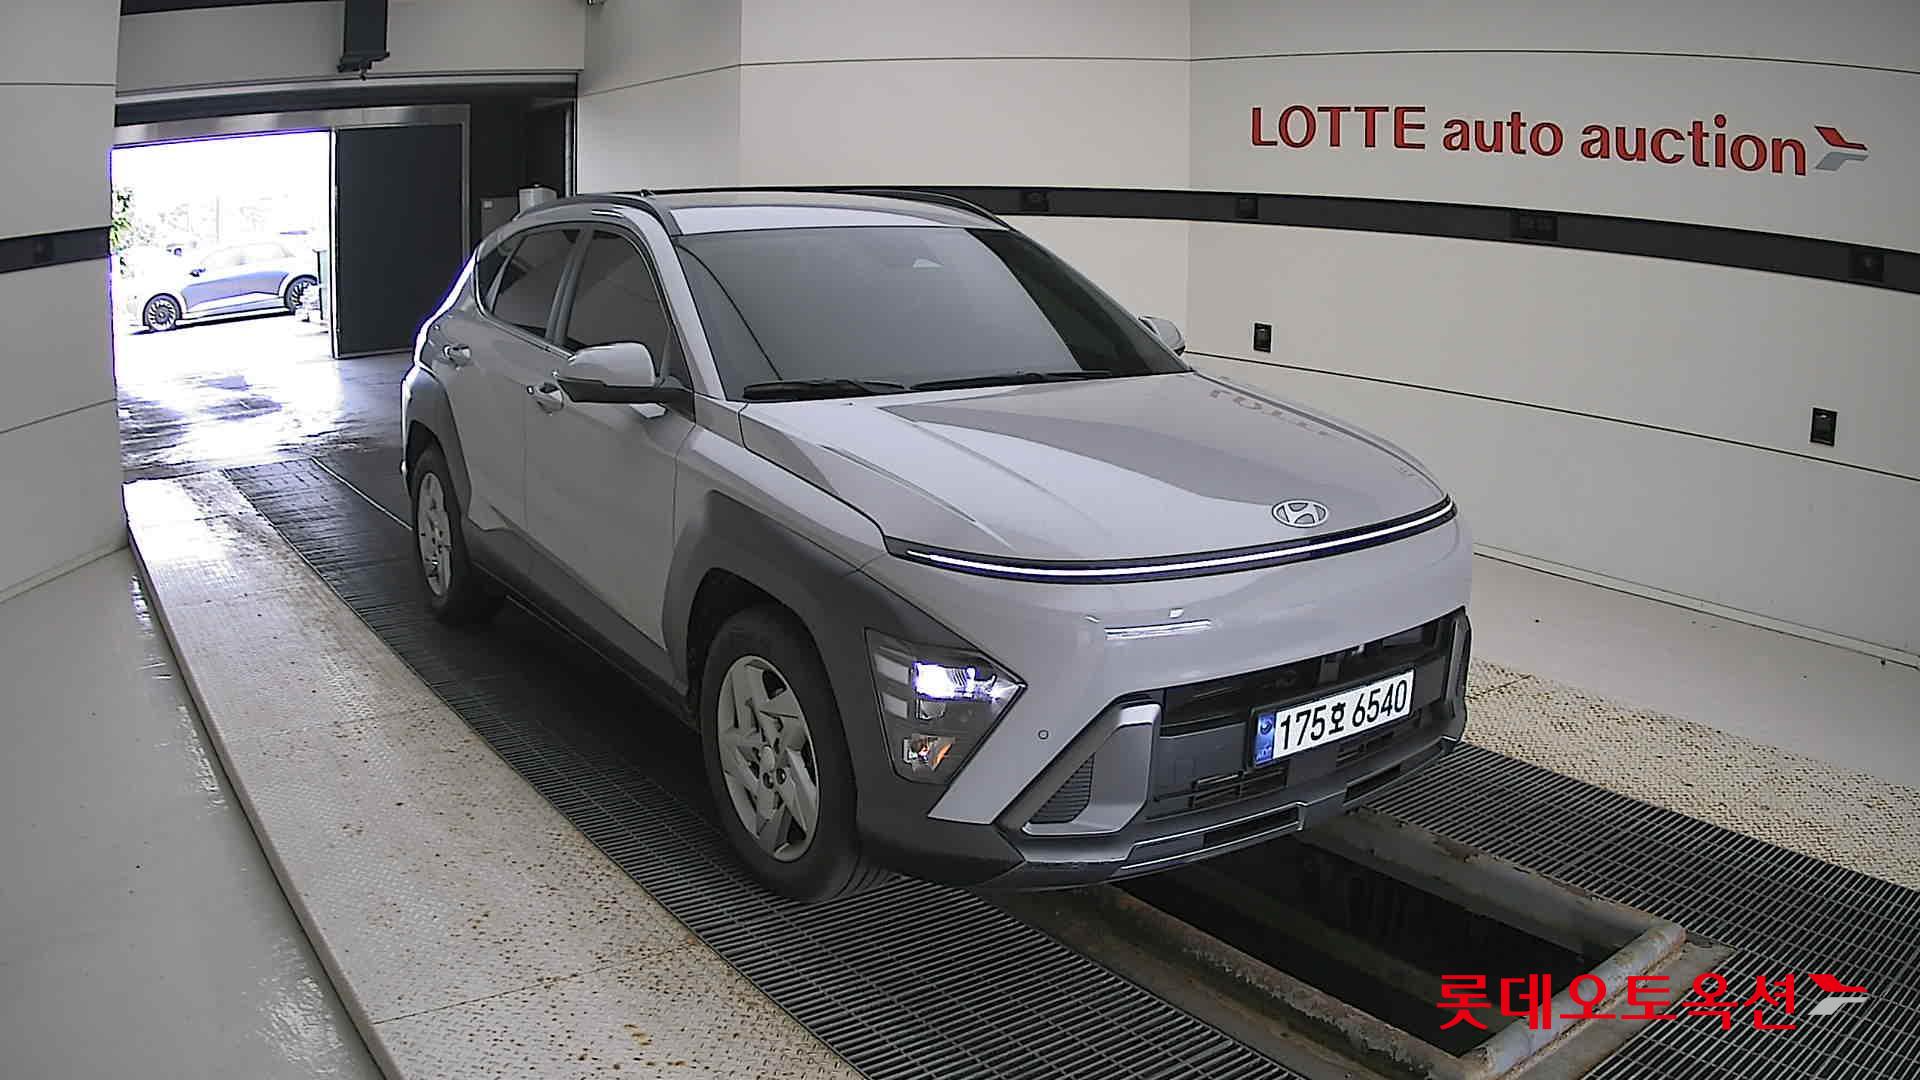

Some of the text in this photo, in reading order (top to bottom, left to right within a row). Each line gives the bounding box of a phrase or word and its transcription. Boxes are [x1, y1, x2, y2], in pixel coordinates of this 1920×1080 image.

[1251, 105, 1808, 177] LOTTE auto auction
[1280, 679, 1408, 750] 175호 6540
